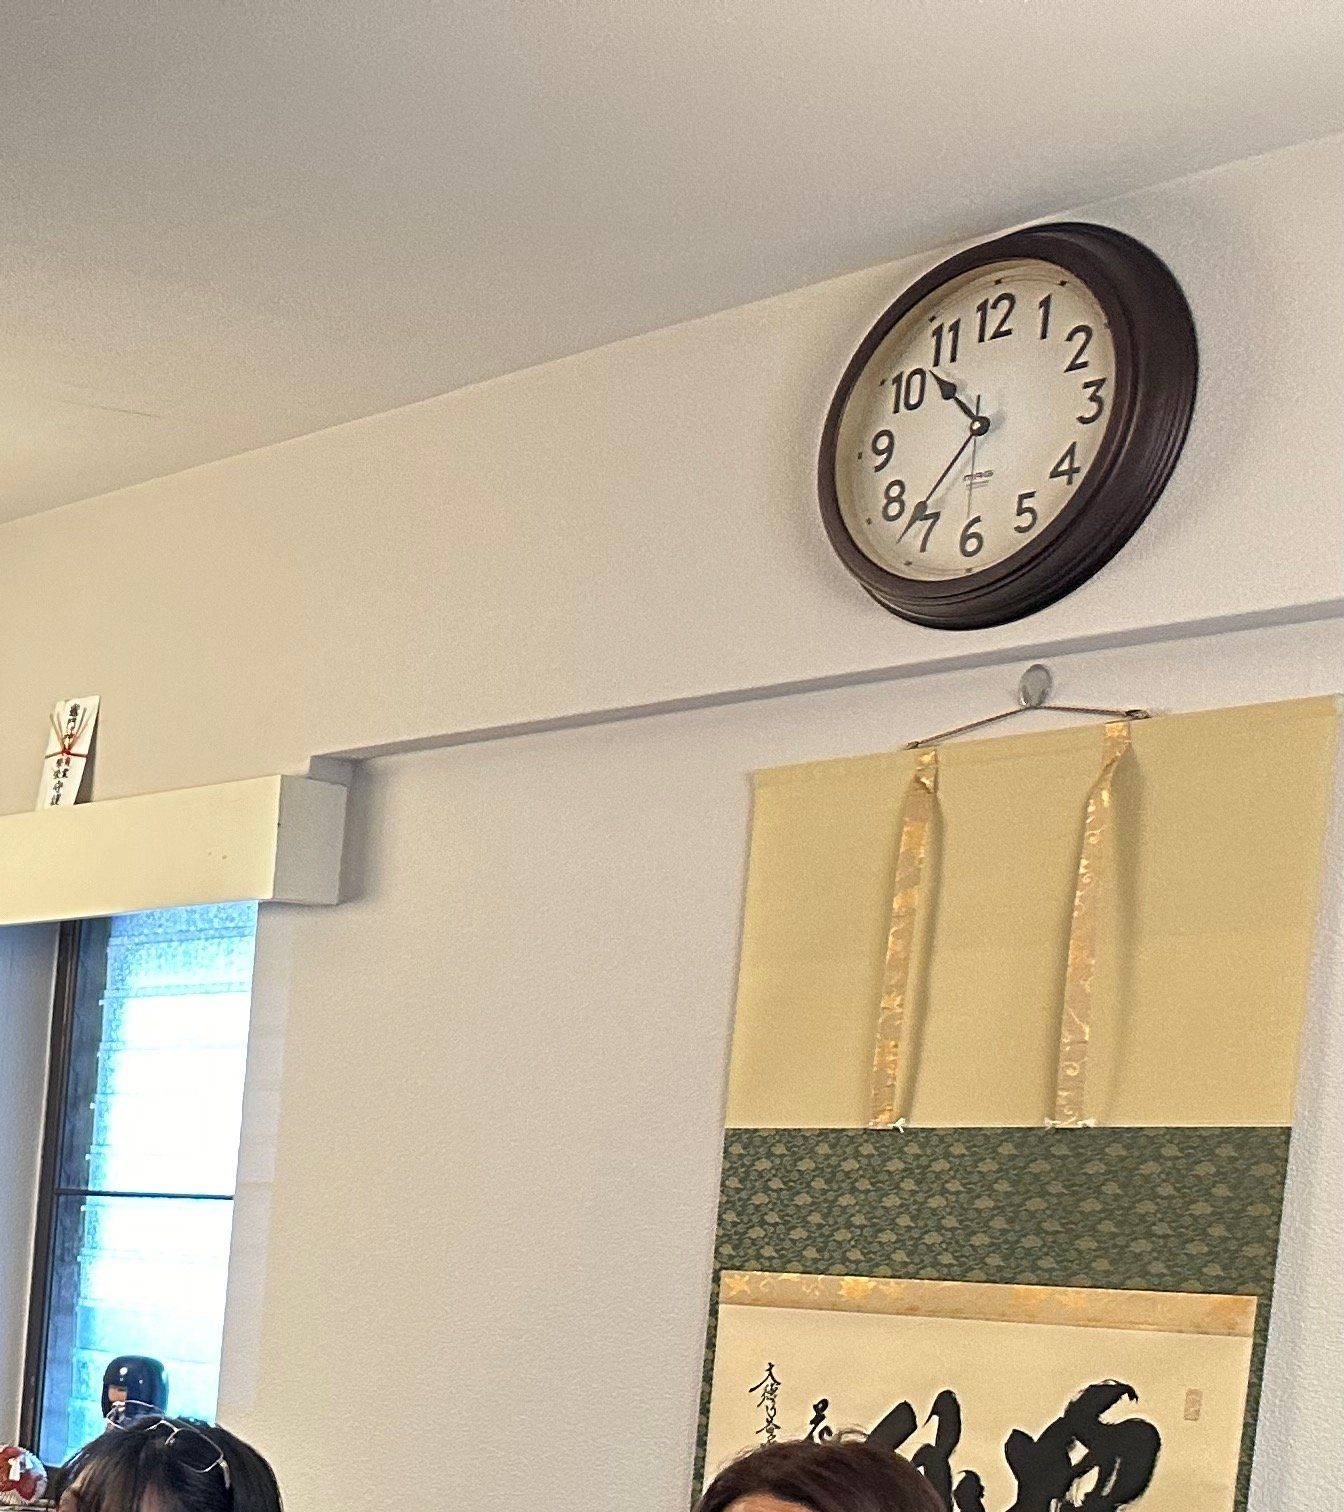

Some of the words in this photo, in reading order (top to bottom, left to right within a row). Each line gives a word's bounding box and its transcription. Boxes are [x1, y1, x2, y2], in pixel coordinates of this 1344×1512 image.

[976, 292, 1017, 343] 12
[1038, 293, 1052, 340] 1
[931, 318, 961, 367] 11
[1064, 324, 1094, 373] 2
[891, 367, 927, 414] 10
[1076, 377, 1107, 425] 3
[871, 429, 895, 473] 9
[1049, 441, 1081, 485] 4
[881, 479, 906, 522] 8
[1013, 490, 1038, 534] 5
[918, 511, 942, 553] 7
[959, 515, 985, 557] 6
